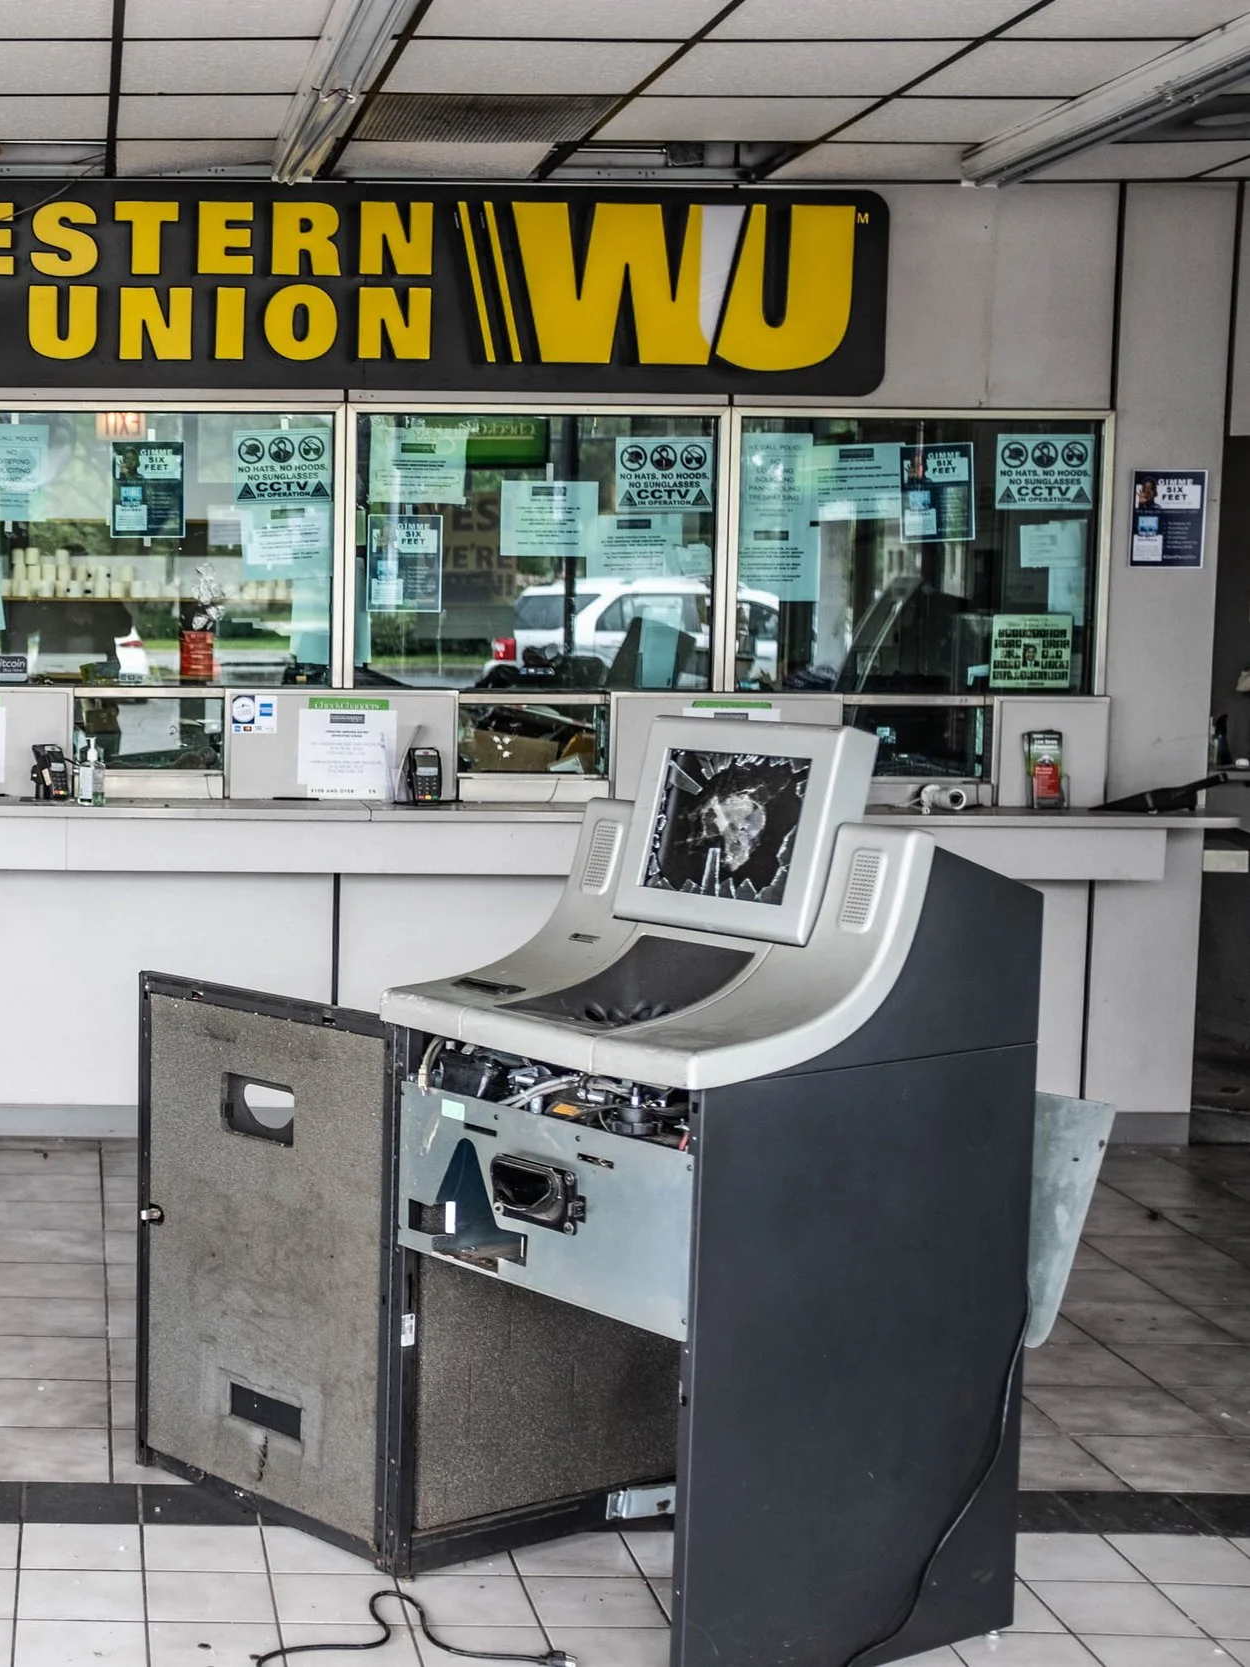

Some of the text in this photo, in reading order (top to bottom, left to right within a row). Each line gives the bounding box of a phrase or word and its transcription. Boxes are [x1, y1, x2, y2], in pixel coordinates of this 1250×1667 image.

[512, 201, 856, 371] WU
[28, 284, 432, 361] UNION
[140, 448, 173, 456] GIMME
[928, 451, 961, 459] GIMME
[262, 472, 319, 480] SUNGLASSES
[255, 481, 308, 492] CCTV
[1158, 478, 1194, 486] GIMME
[637, 489, 690, 499] CCTV
[1017, 486, 1070, 496] CCTV
[405, 530, 422, 538] SIX
